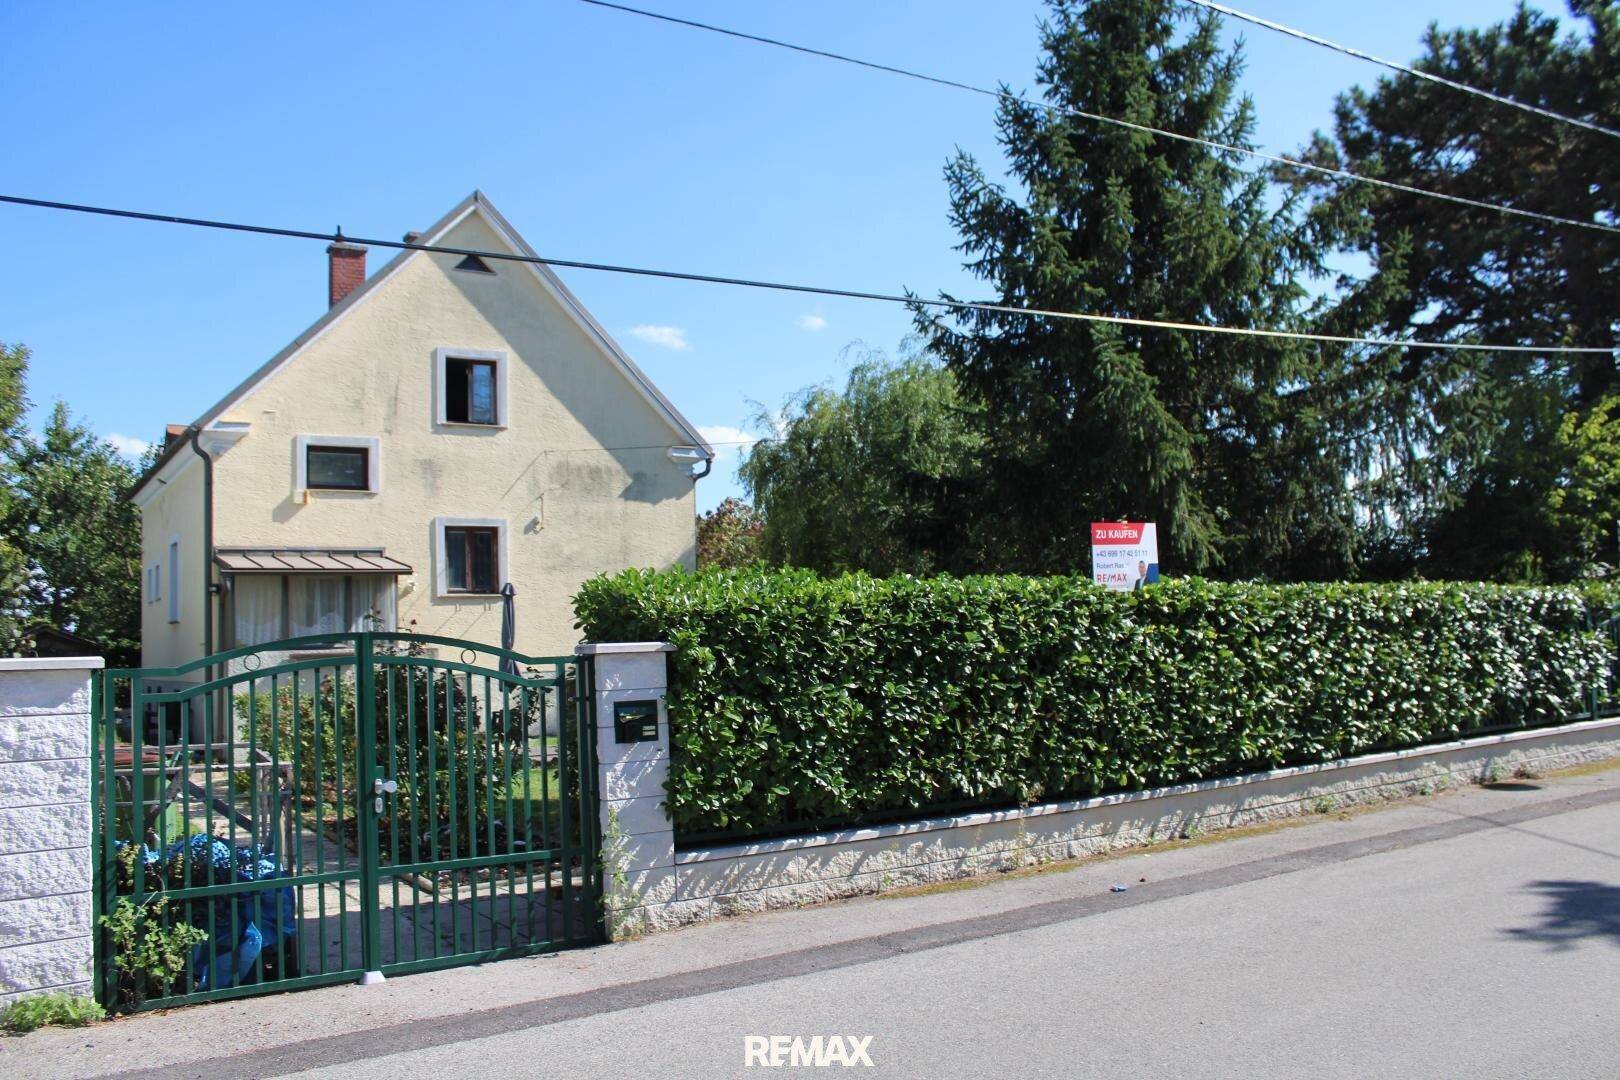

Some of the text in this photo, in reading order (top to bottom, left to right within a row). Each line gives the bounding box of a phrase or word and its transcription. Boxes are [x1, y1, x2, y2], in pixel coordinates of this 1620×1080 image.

[1096, 530, 1138, 538] ZU KAUFEN
[1097, 573, 1127, 582] RE/MAX
